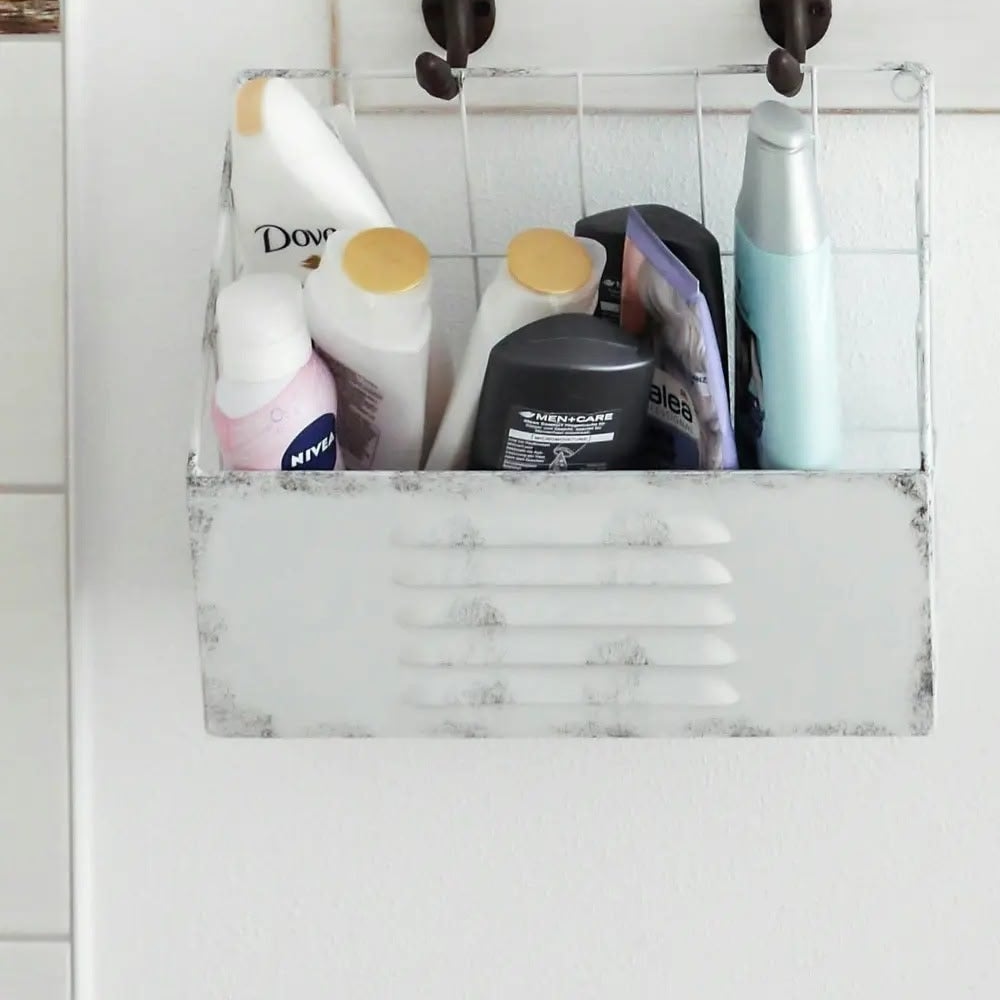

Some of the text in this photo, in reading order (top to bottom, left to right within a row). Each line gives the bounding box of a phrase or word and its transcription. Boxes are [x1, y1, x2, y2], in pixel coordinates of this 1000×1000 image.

[535, 412, 614, 423] MEN+CARE
[649, 383, 693, 424] alea
[290, 431, 335, 467] NIVEA
